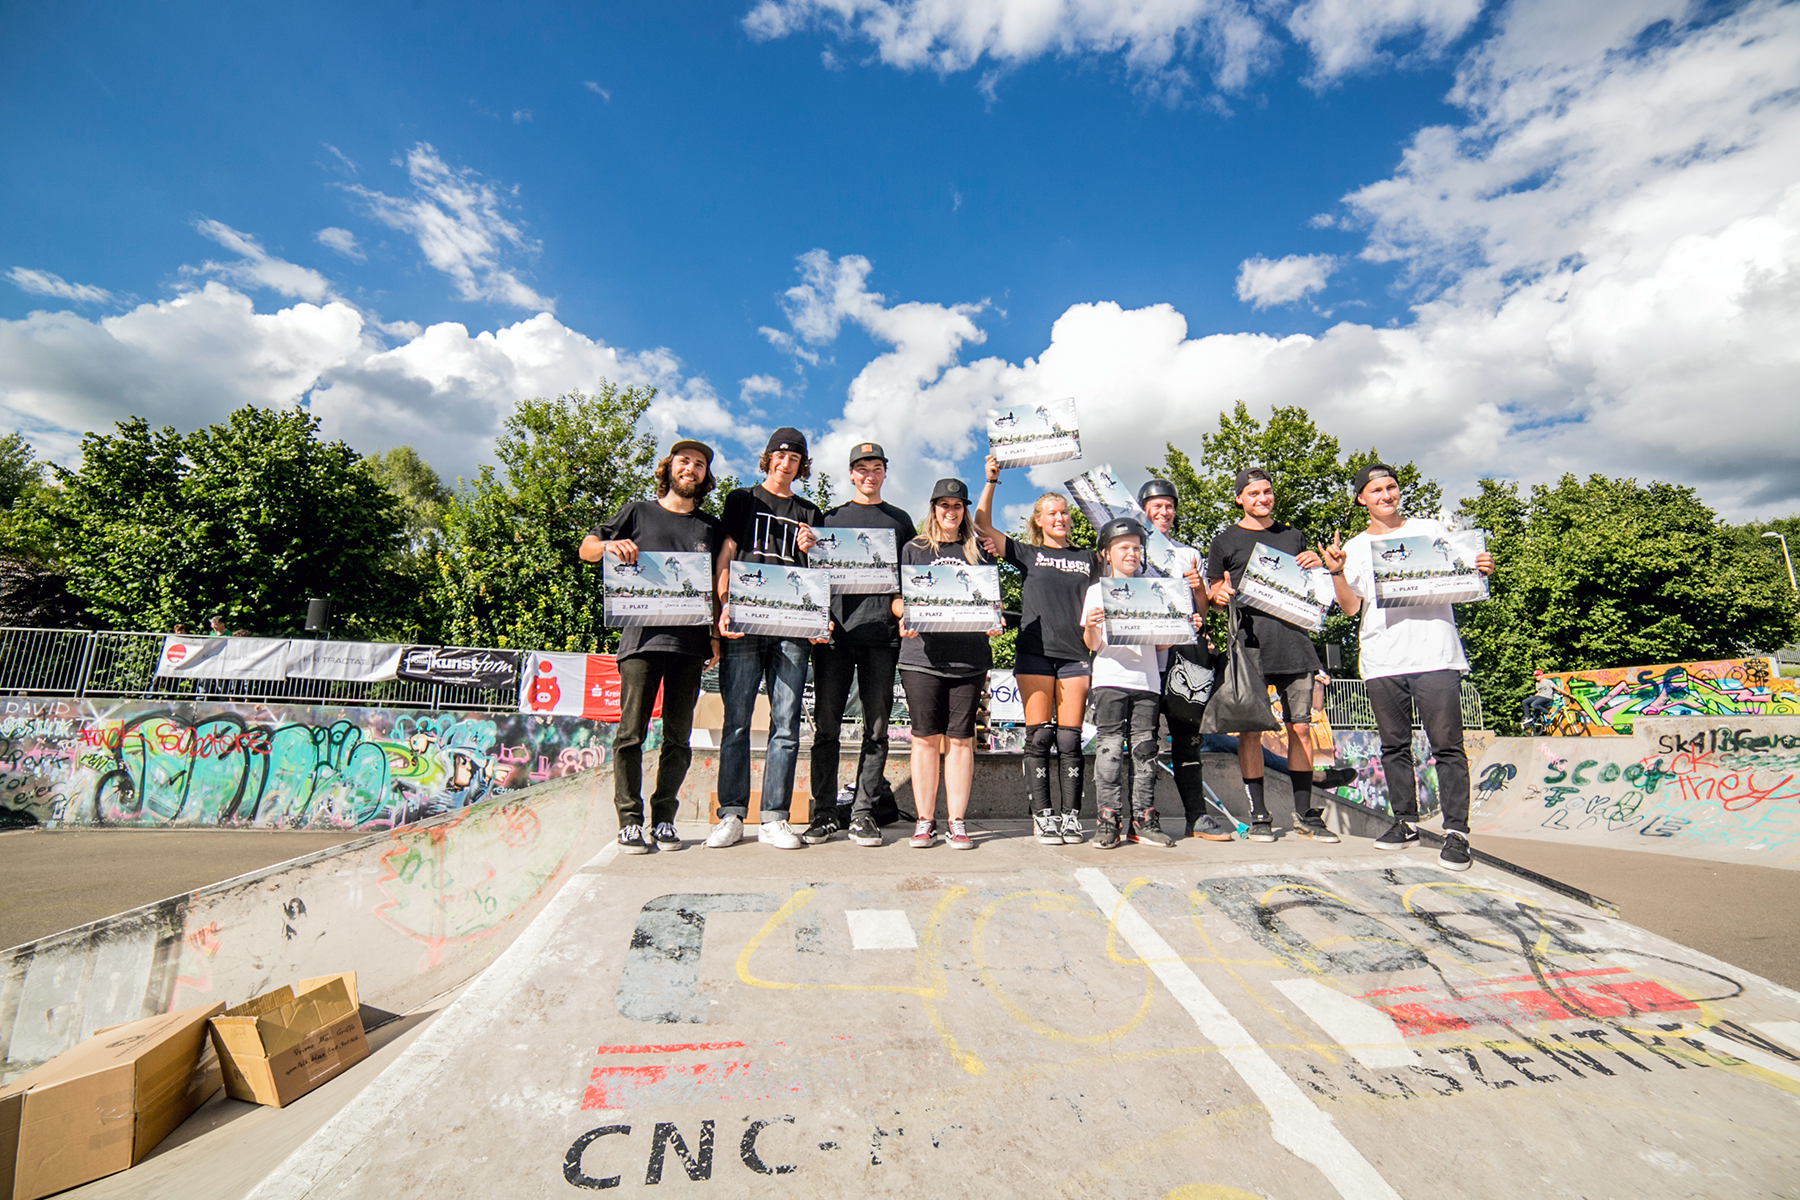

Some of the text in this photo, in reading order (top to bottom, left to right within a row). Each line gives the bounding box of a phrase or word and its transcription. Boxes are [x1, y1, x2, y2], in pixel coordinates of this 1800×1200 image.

[1258, 590, 1274, 599] PLATZ
[431, 653, 515, 676] kunstform
[4, 702, 70, 716] DAVID
